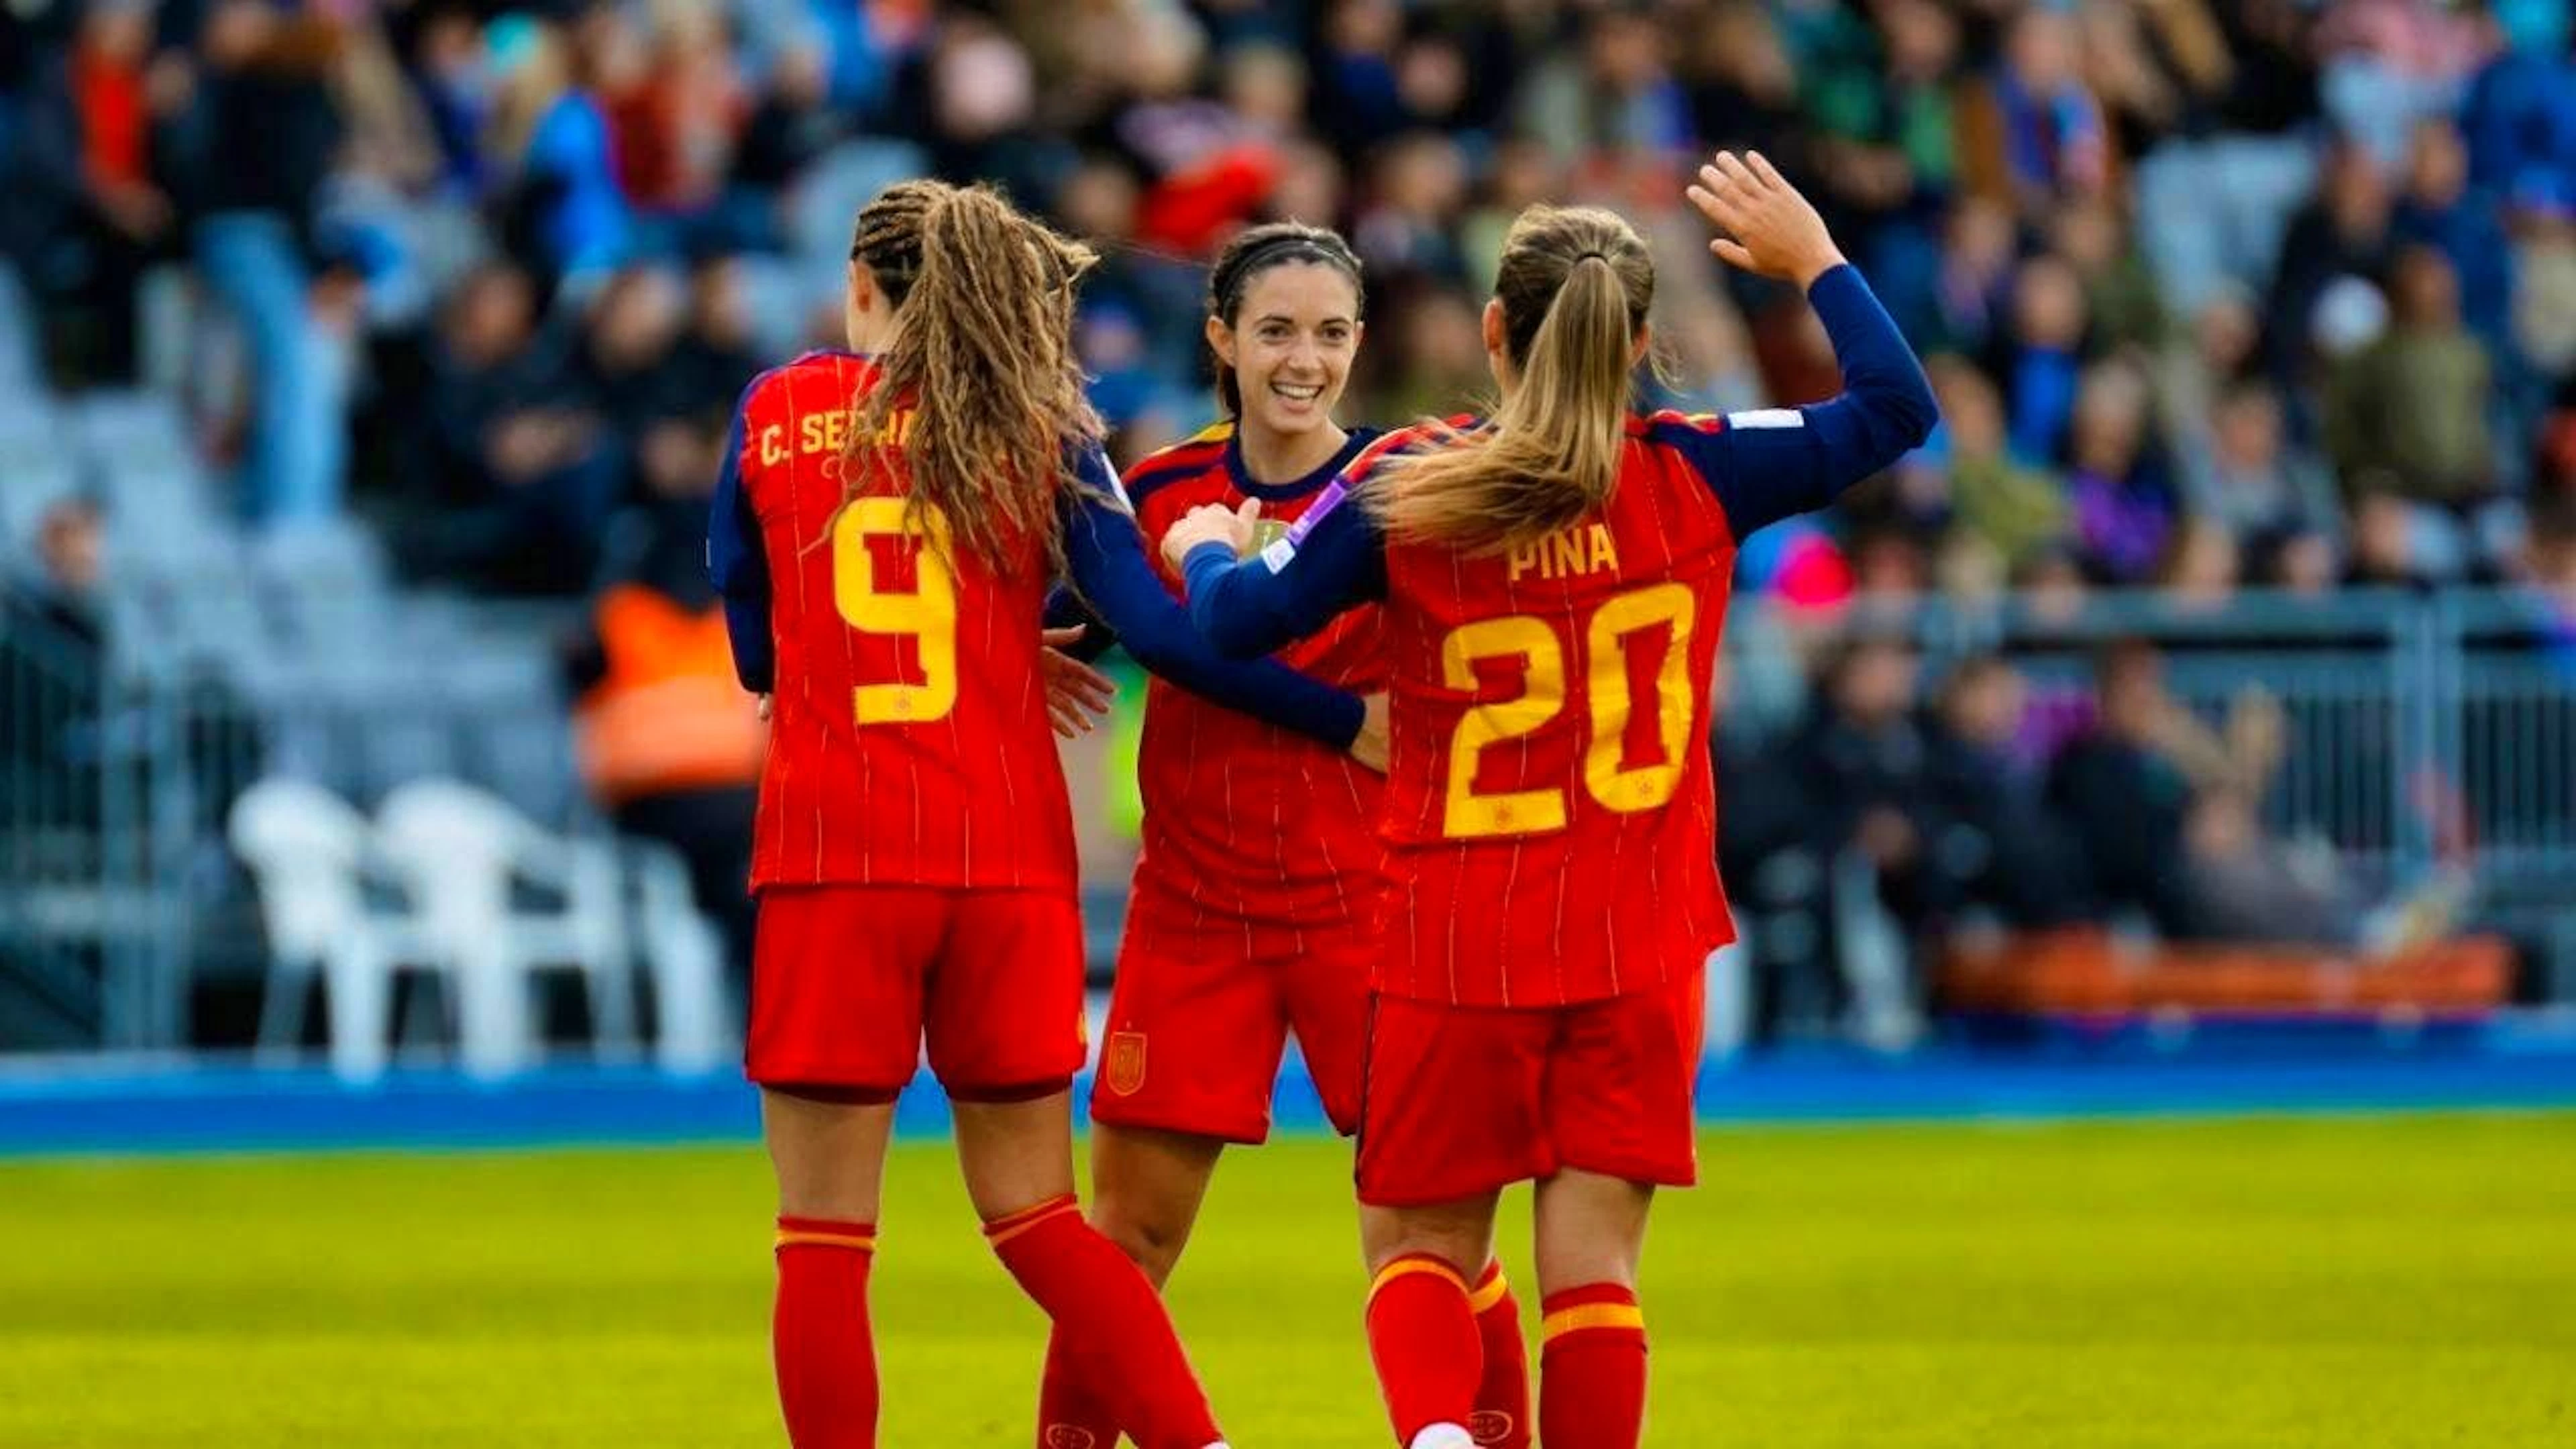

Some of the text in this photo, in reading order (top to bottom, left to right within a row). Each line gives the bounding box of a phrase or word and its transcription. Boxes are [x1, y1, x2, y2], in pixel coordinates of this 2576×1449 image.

[761, 423, 790, 466] C.
[834, 497, 957, 724] 9
[1511, 523, 1619, 580] PINA
[1443, 582, 1695, 838] 20
